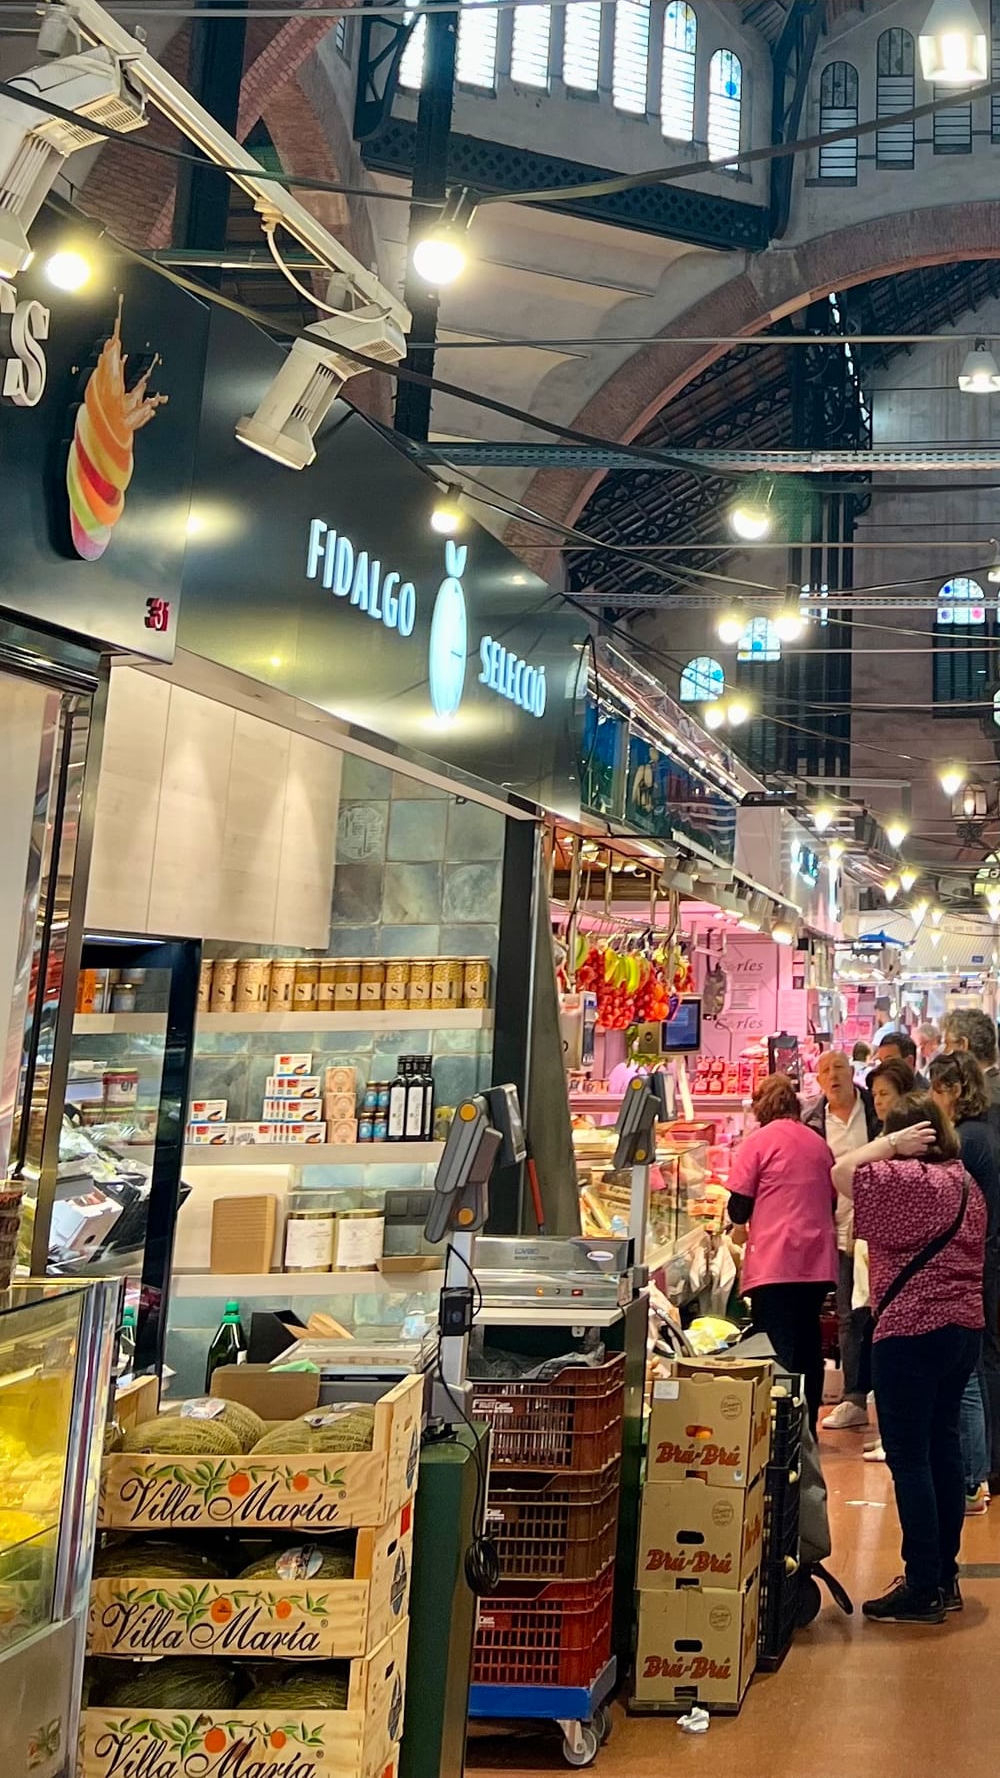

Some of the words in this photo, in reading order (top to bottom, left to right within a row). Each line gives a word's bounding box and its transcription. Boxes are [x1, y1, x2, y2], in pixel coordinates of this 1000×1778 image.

[0, 280, 50, 407] S
[306, 519, 416, 637] FIDALGO
[478, 635, 547, 717] SELECCIÓ
[119, 1477, 202, 1522] Villa
[207, 1479, 340, 1522] María
[101, 1602, 184, 1650] Villa
[189, 1605, 321, 1651] María
[94, 1733, 179, 1778] Villa
[184, 1740, 317, 1778] María
